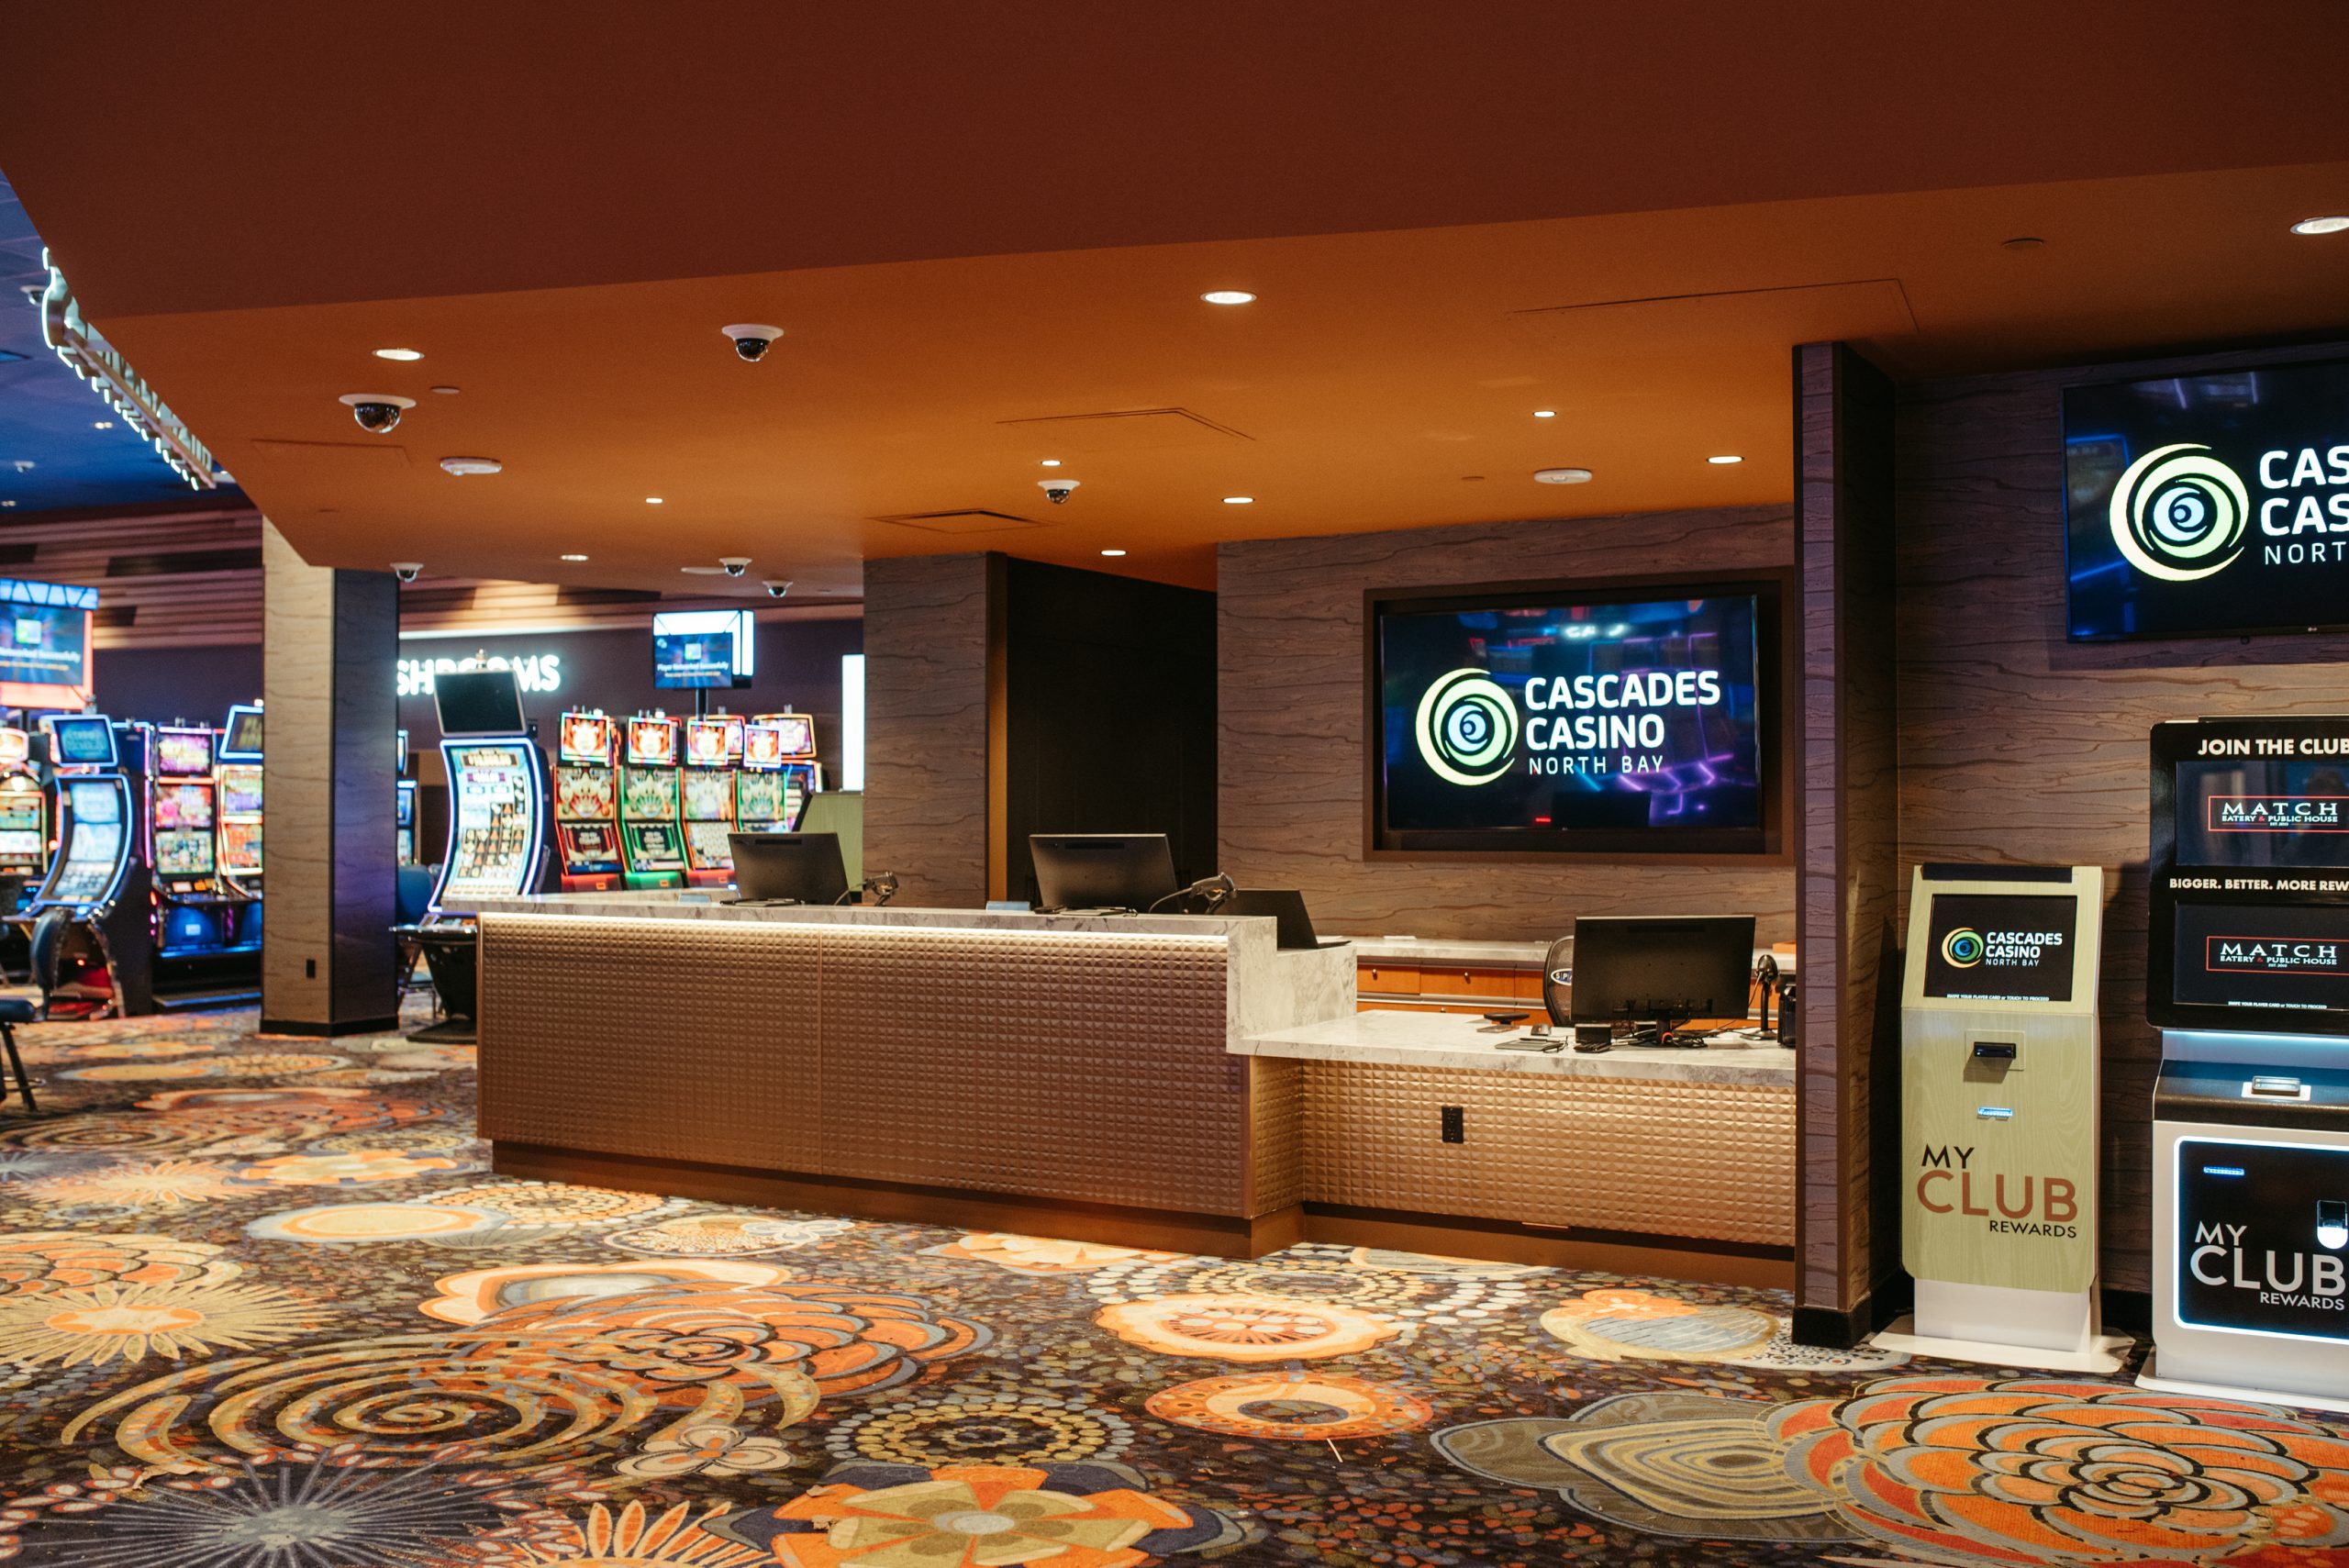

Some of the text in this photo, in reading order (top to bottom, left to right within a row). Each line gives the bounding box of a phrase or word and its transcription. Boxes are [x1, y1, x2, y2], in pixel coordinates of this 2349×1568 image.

[2259, 446, 2349, 489] CAS
[2260, 494, 2349, 536] CAS
[2265, 541, 2347, 565] NORT
[1525, 671, 1720, 710] CASCADES
[1526, 714, 1664, 751] CASINO
[2198, 738, 2349, 755] JOIN THE CLUB
[1529, 755, 1663, 775] NORTH BAY
[2221, 802, 2338, 816] MATCH
[2169, 878, 2349, 892] BIGGER. BETTER. MORE REW
[1987, 931, 2063, 946] CASCADES
[1986, 945, 2041, 959] CASINO
[2220, 942, 2337, 958] MATCH
[1986, 958, 2018, 966] NORTH
[2266, 956, 2300, 964] PUBLIC
[1921, 1143, 1975, 1169] MY
[1917, 1170, 2078, 1222] CLUB
[1989, 1220, 2076, 1239] REWARDS
[2195, 1220, 2247, 1246] MY
[2190, 1245, 2346, 1296] CLUB
[2260, 1292, 2345, 1310] REWARDS
